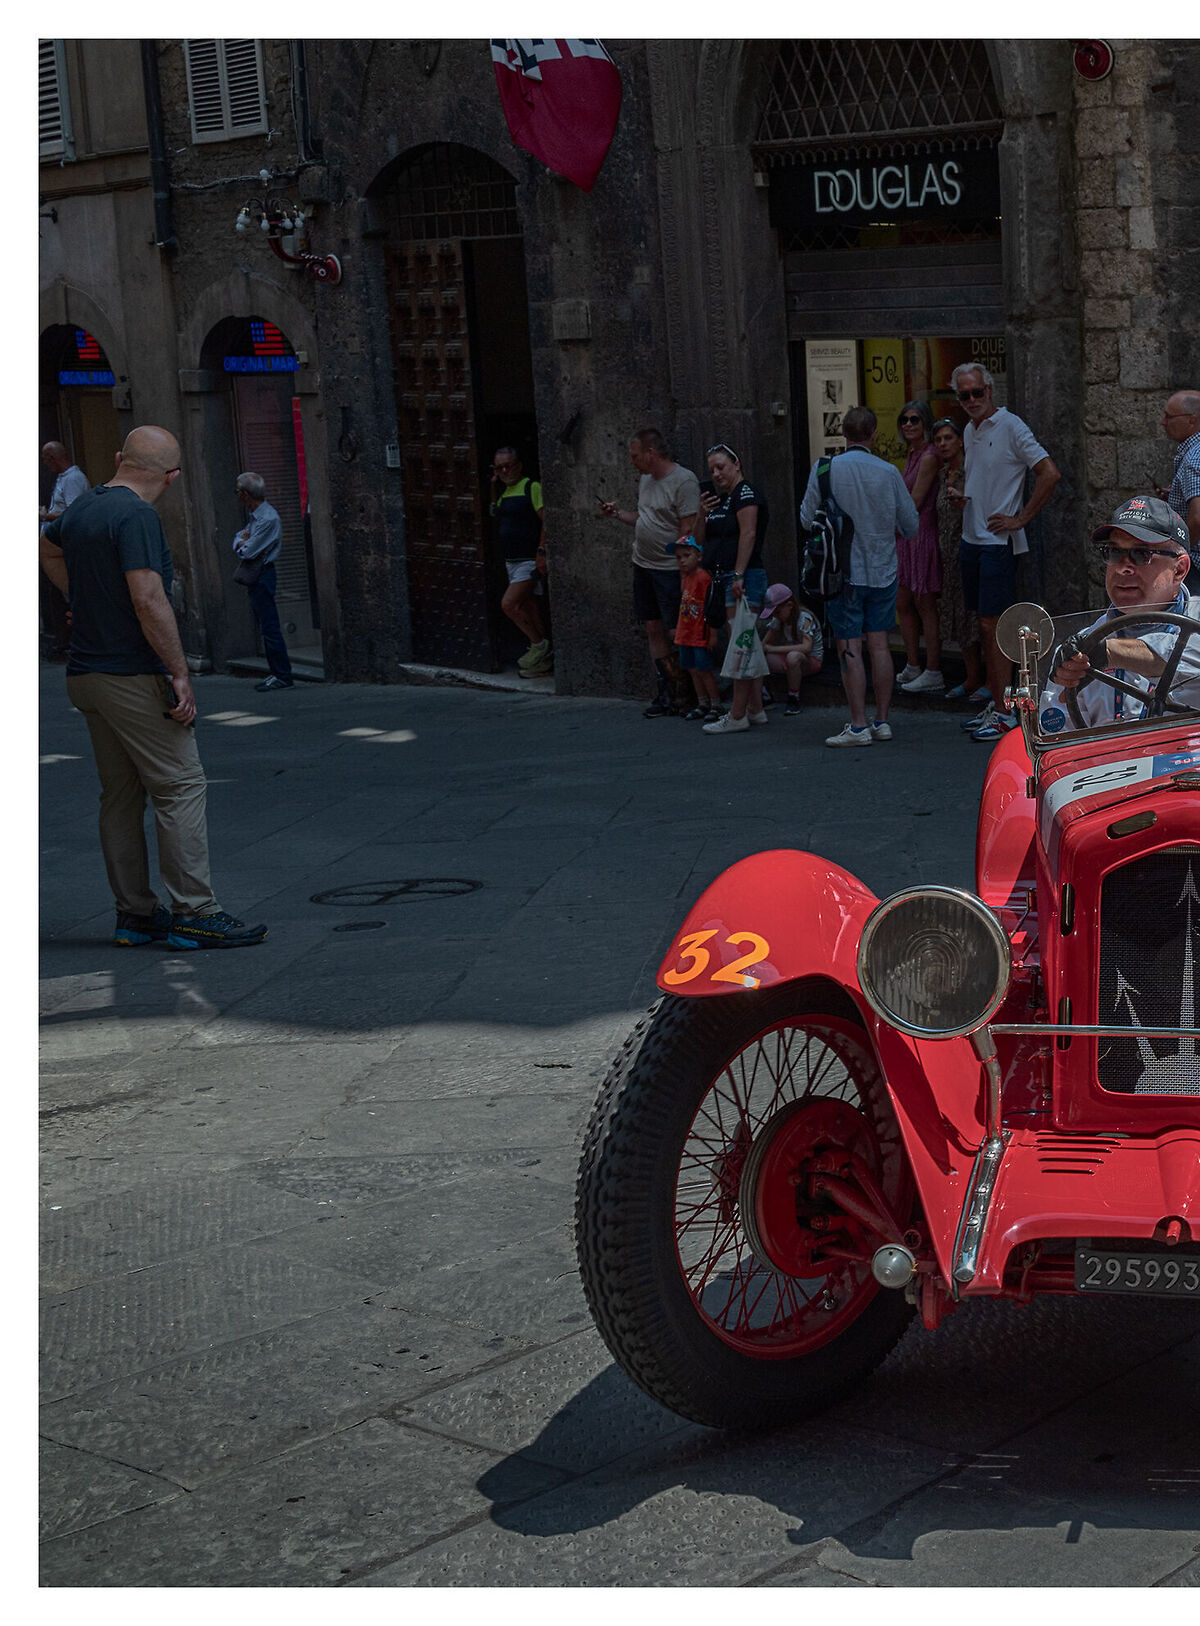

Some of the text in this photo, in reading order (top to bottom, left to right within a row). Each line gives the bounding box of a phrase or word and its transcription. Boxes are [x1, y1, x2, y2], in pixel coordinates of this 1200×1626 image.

[813, 160, 962, 213] DOUGLAS
[1176, 527, 1186, 541] 32
[1072, 765, 1138, 793] 32
[663, 929, 770, 991] 32
[1085, 1256, 1200, 1291] 295993
